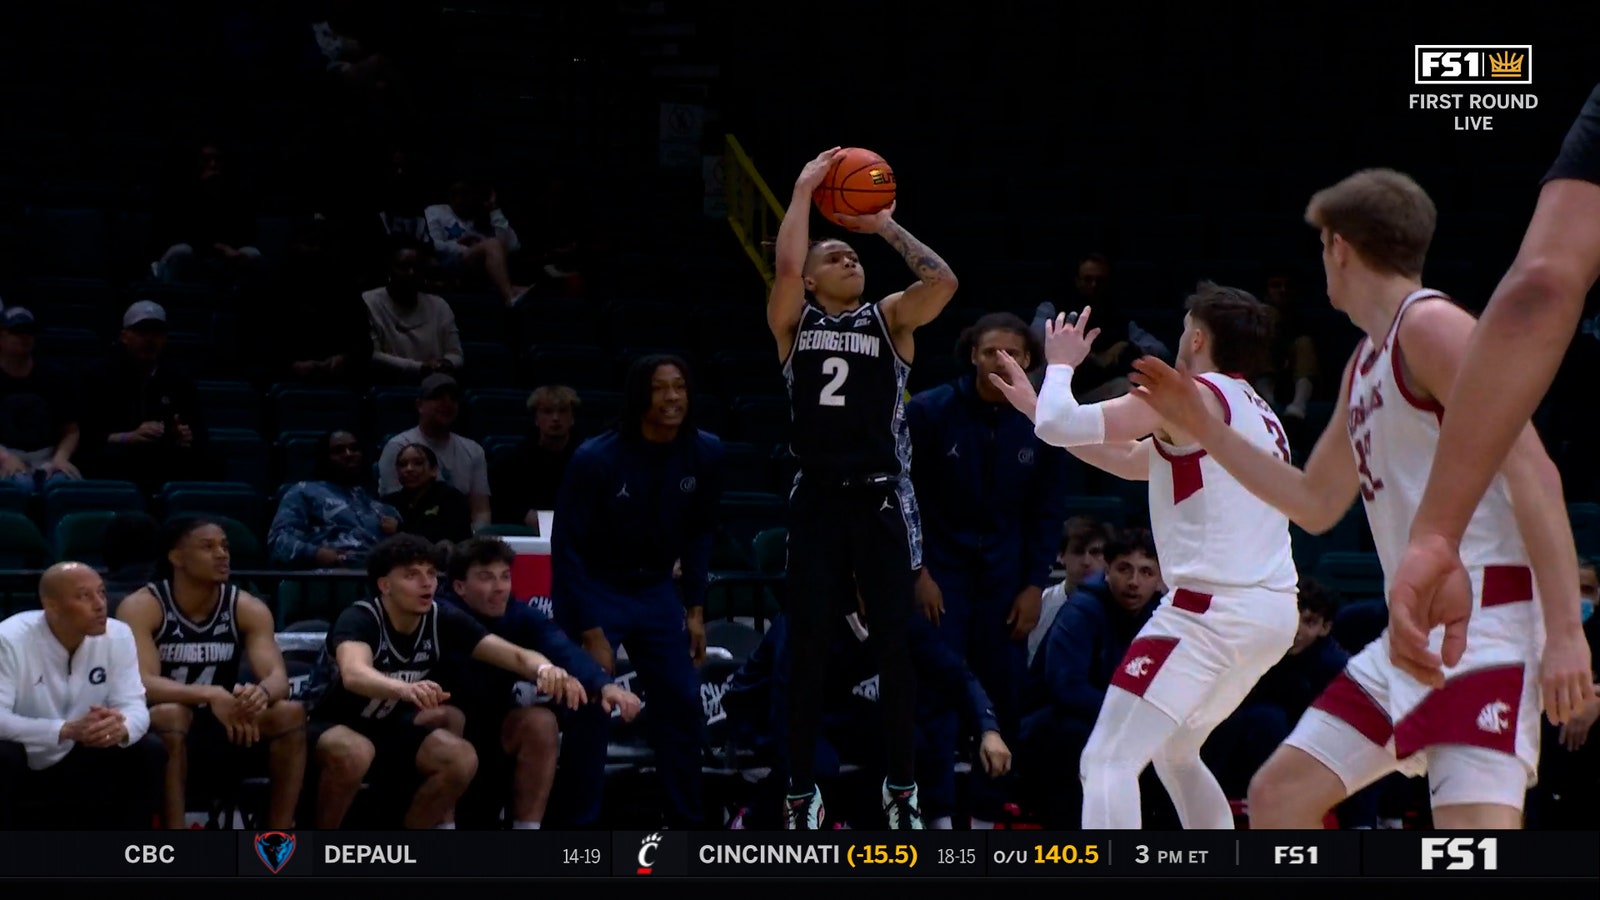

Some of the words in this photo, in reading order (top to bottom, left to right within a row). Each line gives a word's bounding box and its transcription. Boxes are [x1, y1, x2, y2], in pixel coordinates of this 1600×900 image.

[798, 329, 881, 358] GEORGETOWN
[819, 355, 850, 407] 2
[88, 666, 106, 686] G
